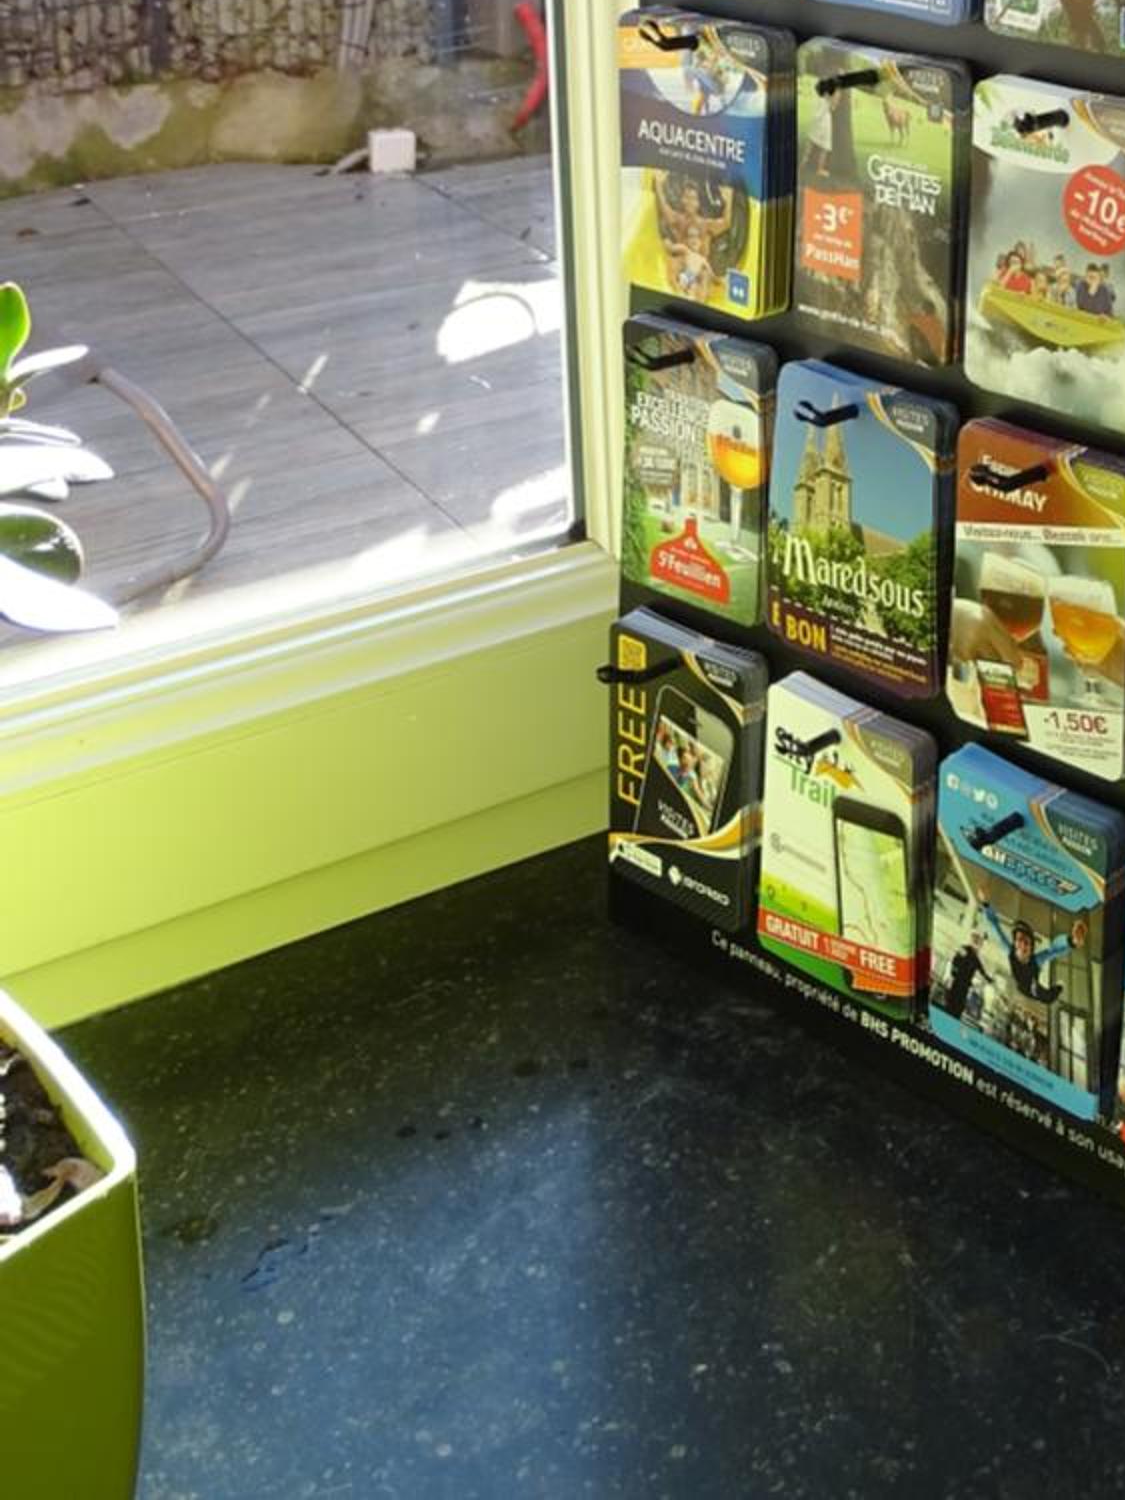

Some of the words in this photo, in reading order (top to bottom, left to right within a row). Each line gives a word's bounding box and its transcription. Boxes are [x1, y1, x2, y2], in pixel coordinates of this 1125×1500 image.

[637, 118, 746, 165] AQUACENTRE
[783, 534, 925, 619] Maredsous
[785, 613, 826, 652] BON
[618, 682, 646, 805] FREE
[765, 914, 820, 950] GRATUIT
[859, 948, 897, 977] FREE
[712, 930, 728, 951] Ce
[784, 973, 840, 1013] propriété
[842, 1004, 859, 1023] de
[860, 1012, 889, 1039] BHS
[891, 1027, 974, 1085] PROMOTION
[976, 1076, 999, 1099] est
[1000, 1089, 1053, 1130] réservé
[1055, 1118, 1066, 1137] à
[1068, 1129, 1095, 1152] son
